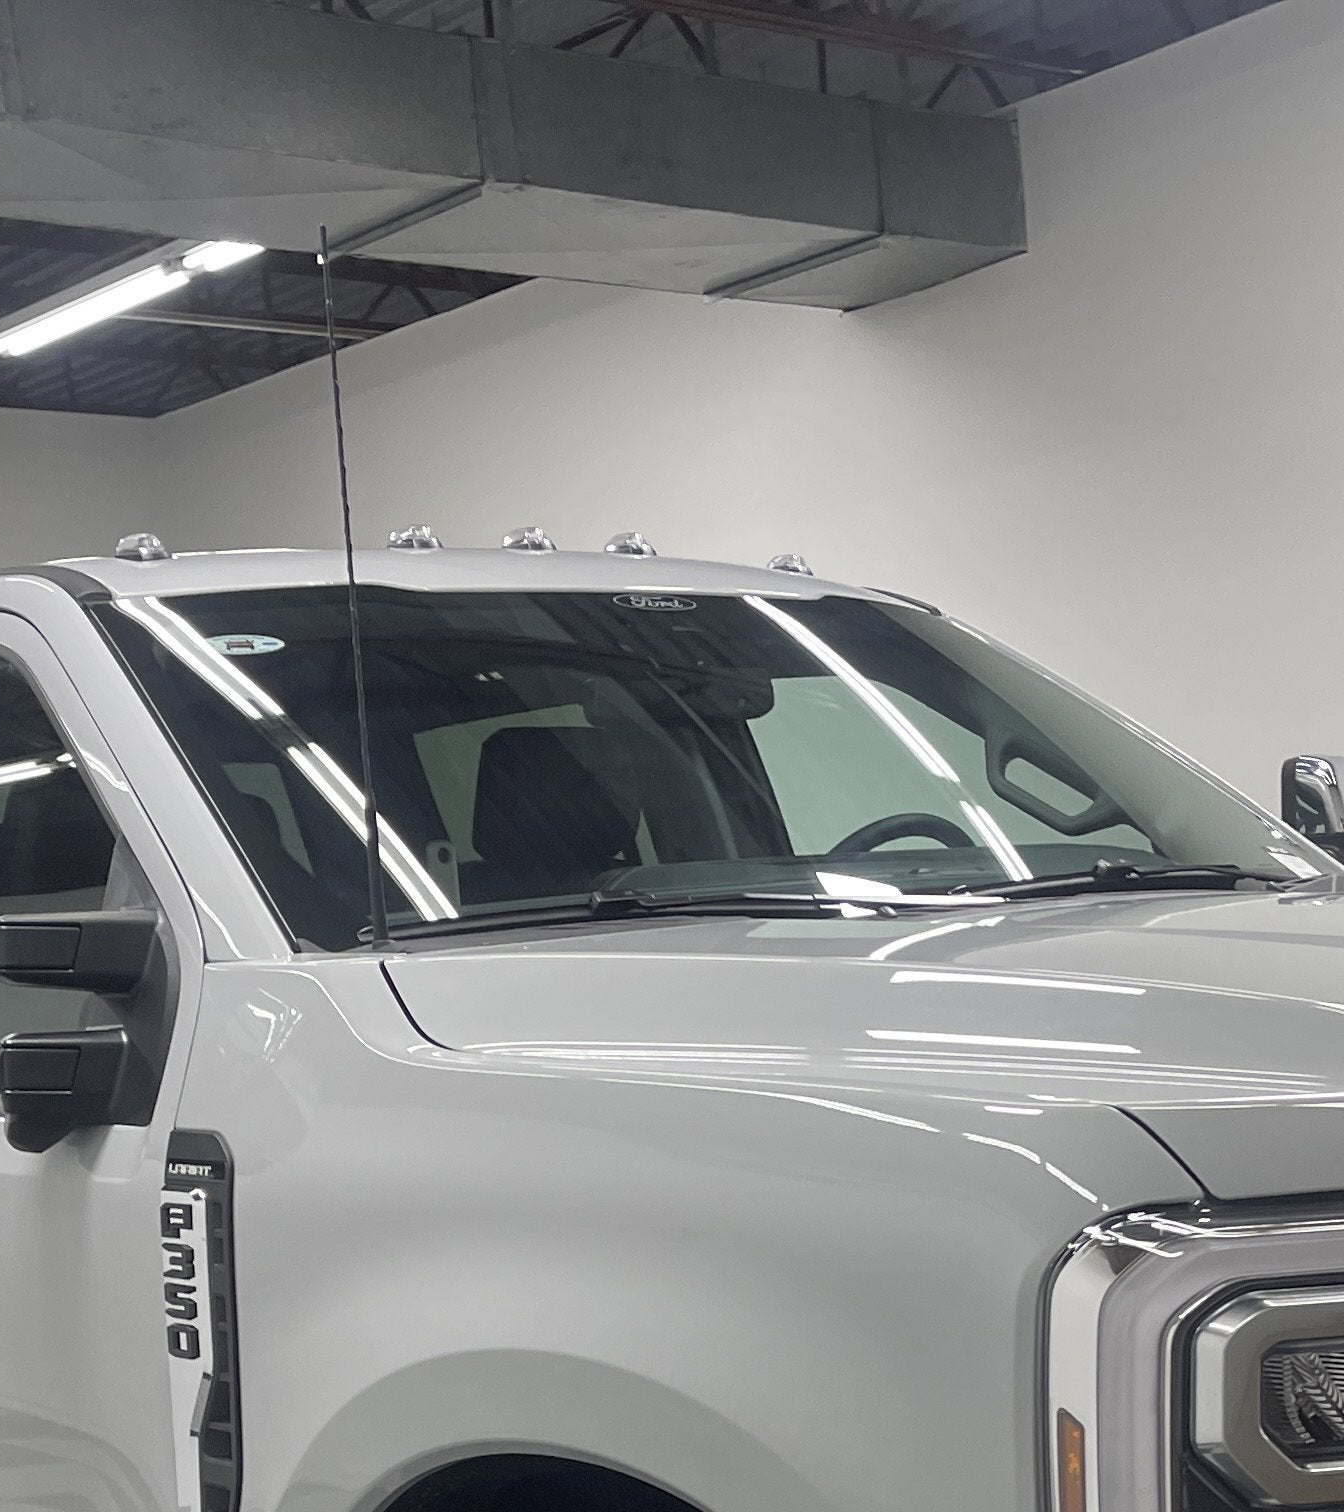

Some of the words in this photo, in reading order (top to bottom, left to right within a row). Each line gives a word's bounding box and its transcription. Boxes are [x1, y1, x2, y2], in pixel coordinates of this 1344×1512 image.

[629, 596, 684, 608] Ford
[168, 1162, 212, 1177] LARIAT
[160, 1202, 200, 1360] F350
